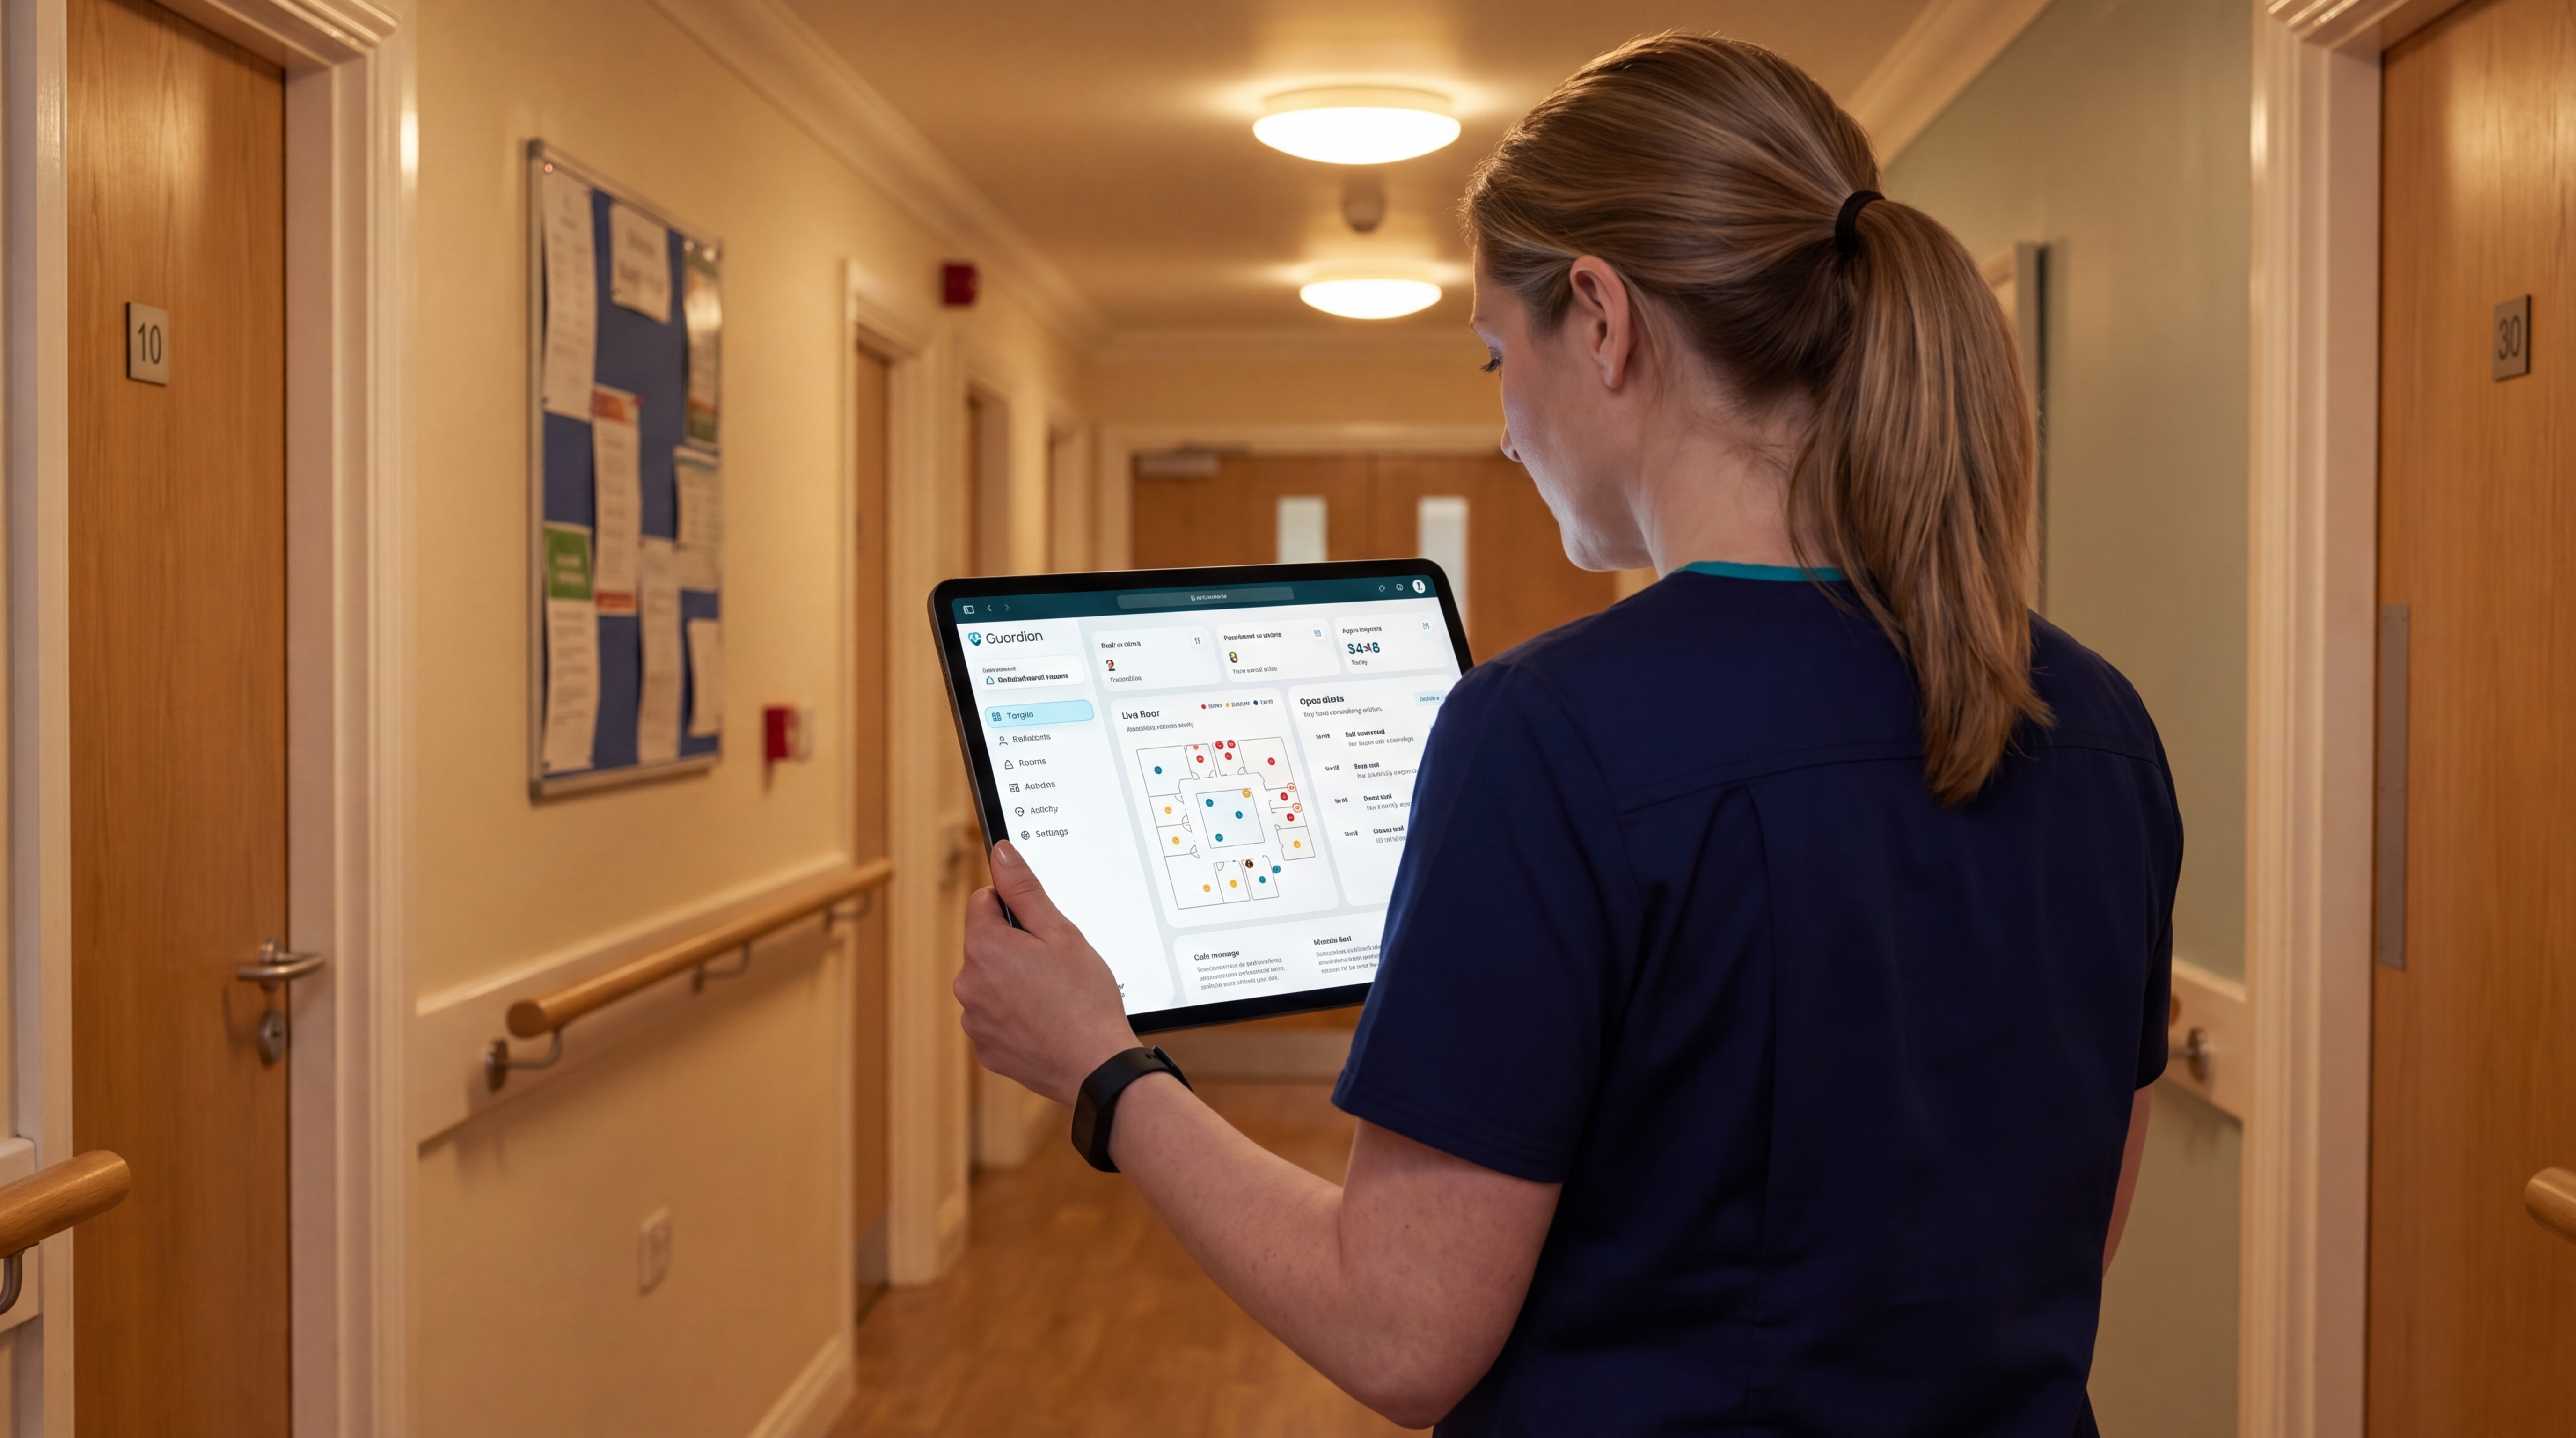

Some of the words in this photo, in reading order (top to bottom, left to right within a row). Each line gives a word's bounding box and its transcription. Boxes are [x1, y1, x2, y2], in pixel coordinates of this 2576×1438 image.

[138, 322, 161, 364] 10
[2498, 315, 2522, 360] 30
[1019, 758, 1046, 767] Rooms
